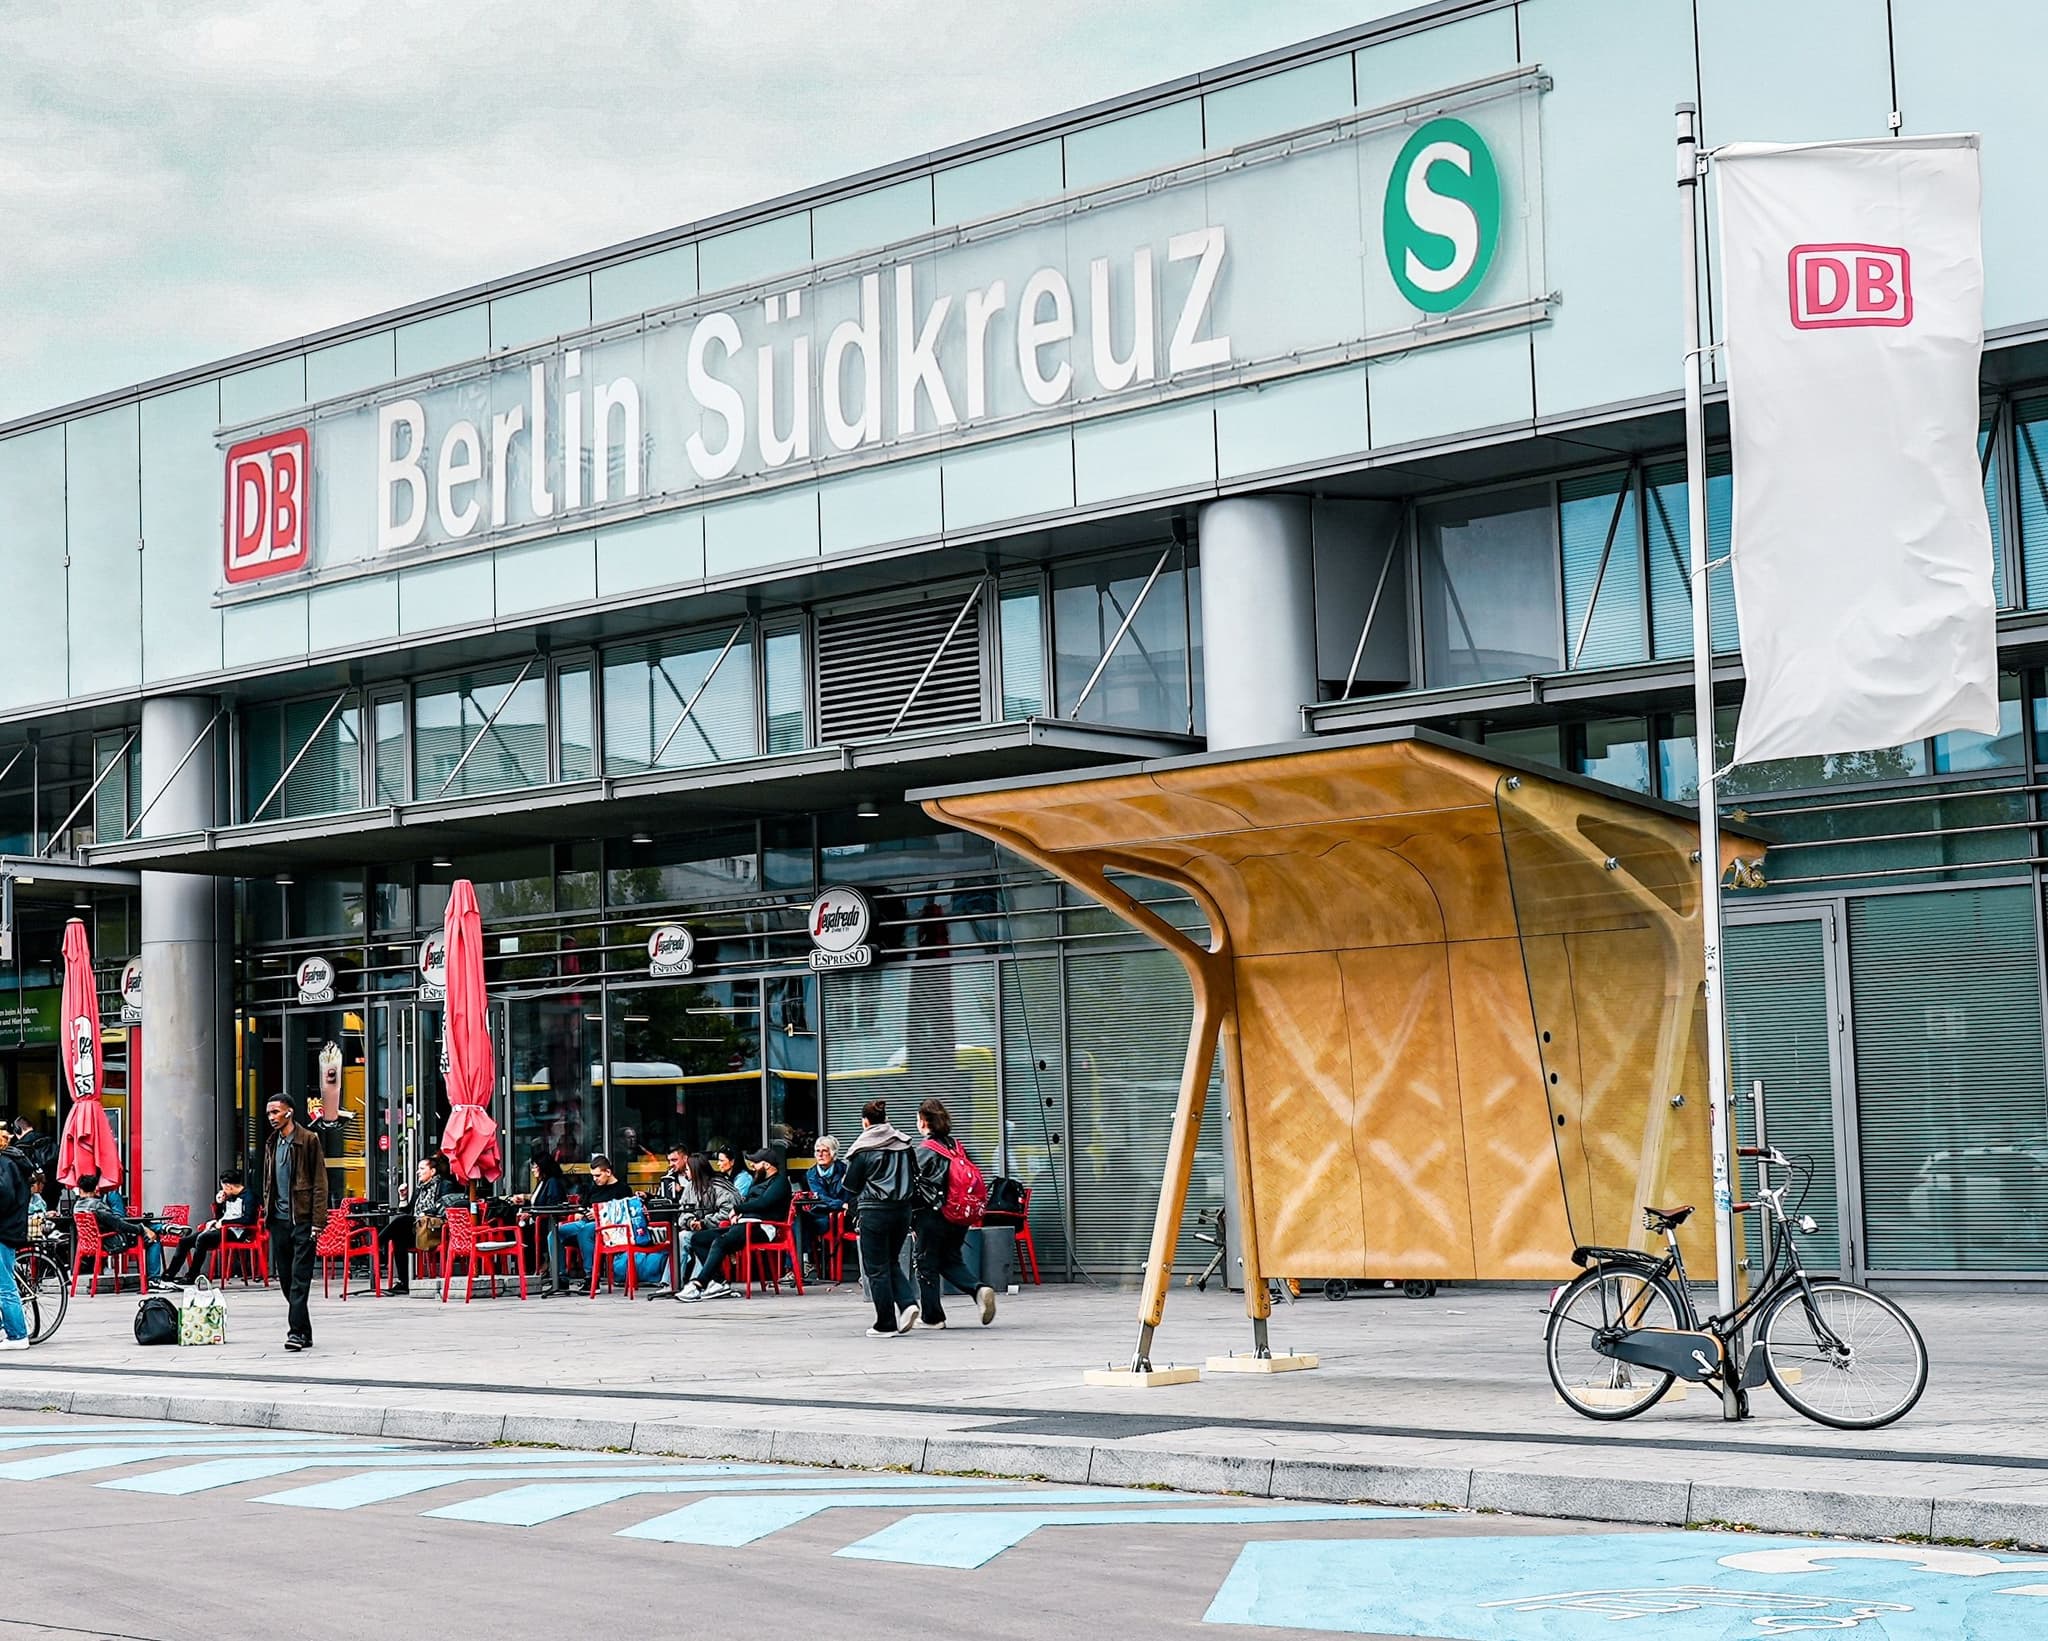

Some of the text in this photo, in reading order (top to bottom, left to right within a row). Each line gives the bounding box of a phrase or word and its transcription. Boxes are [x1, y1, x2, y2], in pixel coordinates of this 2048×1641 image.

[1404, 141, 1479, 294] S
[1805, 257, 1898, 315] DB
[378, 226, 1231, 552] Berlin Südkreuz
[236, 452, 297, 558] DB
[423, 941, 445, 972] Segaf
[814, 902, 860, 936] Segafredo
